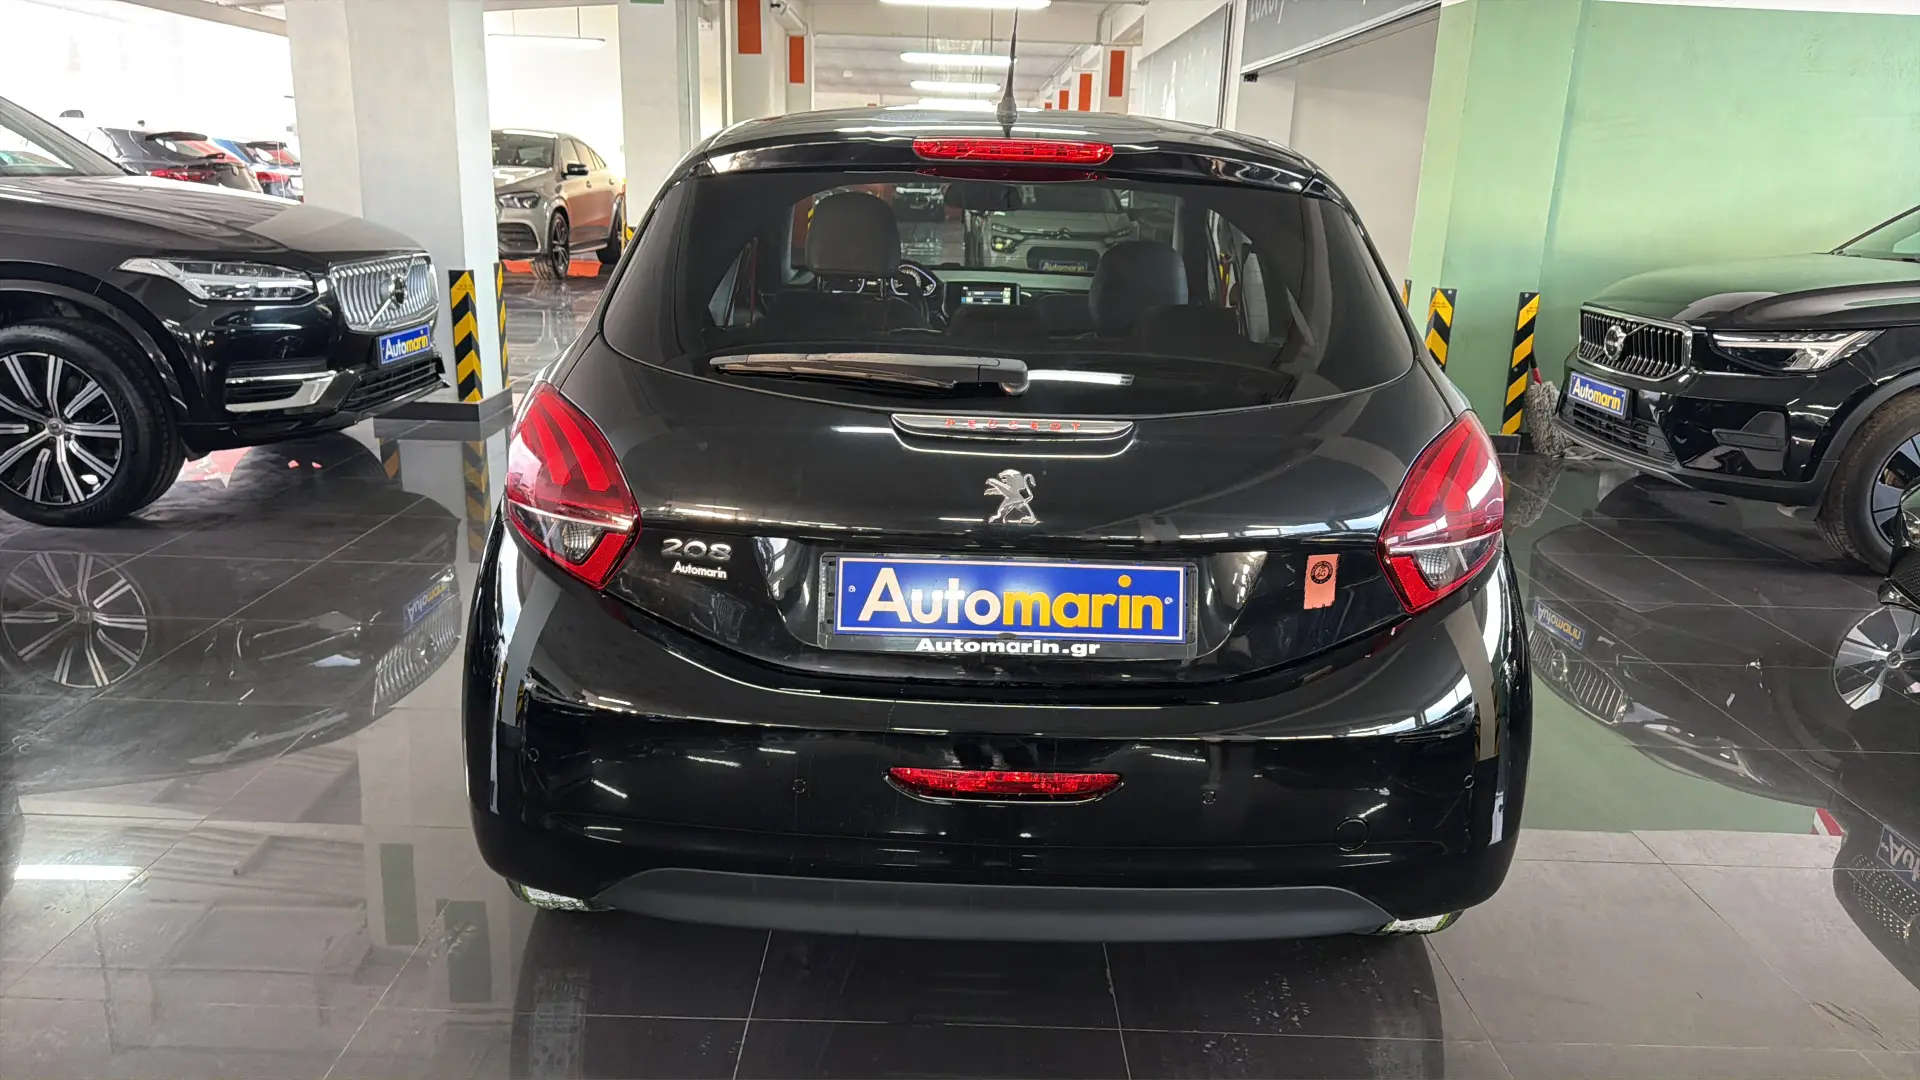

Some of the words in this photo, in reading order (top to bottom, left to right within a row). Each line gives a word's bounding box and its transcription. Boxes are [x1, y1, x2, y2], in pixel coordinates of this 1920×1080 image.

[385, 329, 429, 360] Automarin
[1572, 379, 1621, 411] Automarin
[945, 419, 1081, 431] PEUGEOT
[661, 538, 732, 561] 208
[671, 560, 728, 579] Automarin
[857, 567, 1164, 630] Automarin
[915, 637, 1101, 657] Automarin.gr
